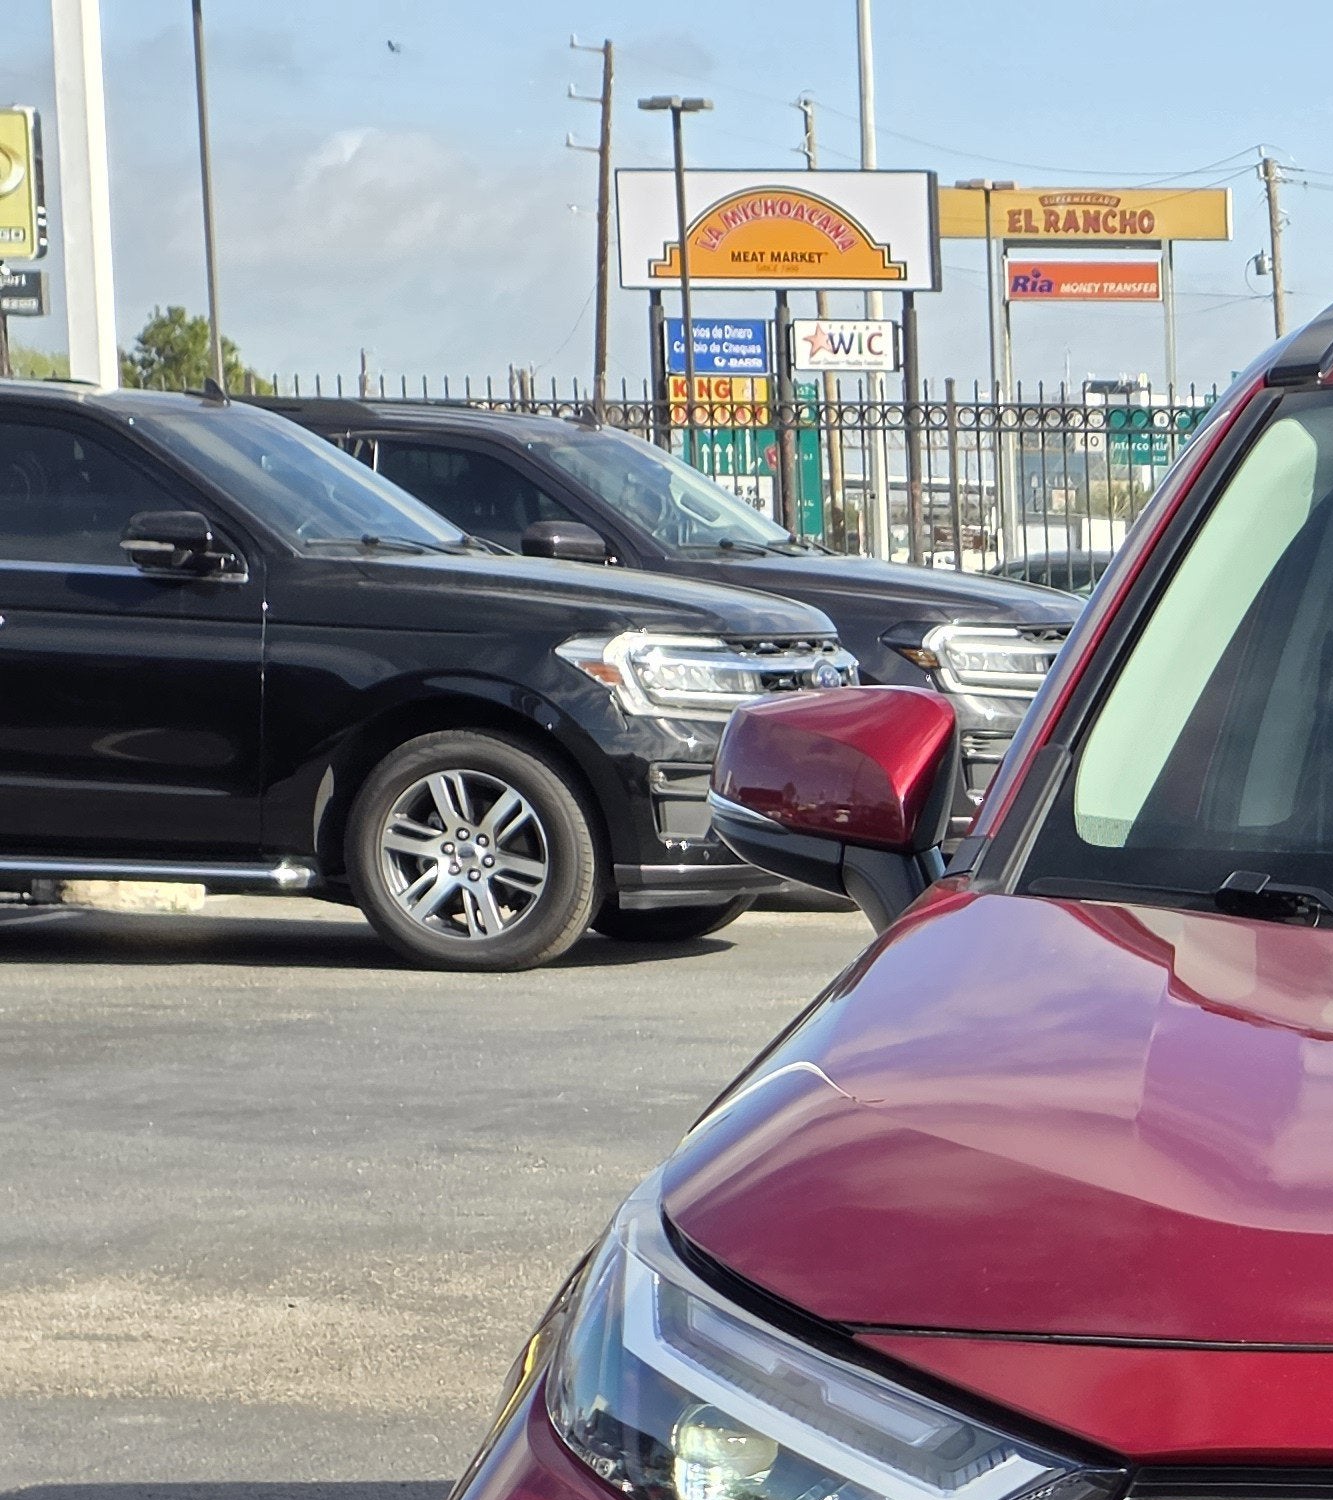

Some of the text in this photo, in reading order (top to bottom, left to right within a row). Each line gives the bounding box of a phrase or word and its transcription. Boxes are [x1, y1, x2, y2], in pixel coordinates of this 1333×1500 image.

[697, 198, 858, 252] LA MICHOACANA
[1006, 208, 1156, 235] EL RANCHO
[731, 251, 823, 264] MEAT MARKET
[1011, 267, 1055, 294] Ria
[1060, 283, 1158, 294] MONEY TRANSFER
[827, 332, 884, 356] WIC
[673, 379, 731, 399] KNG
